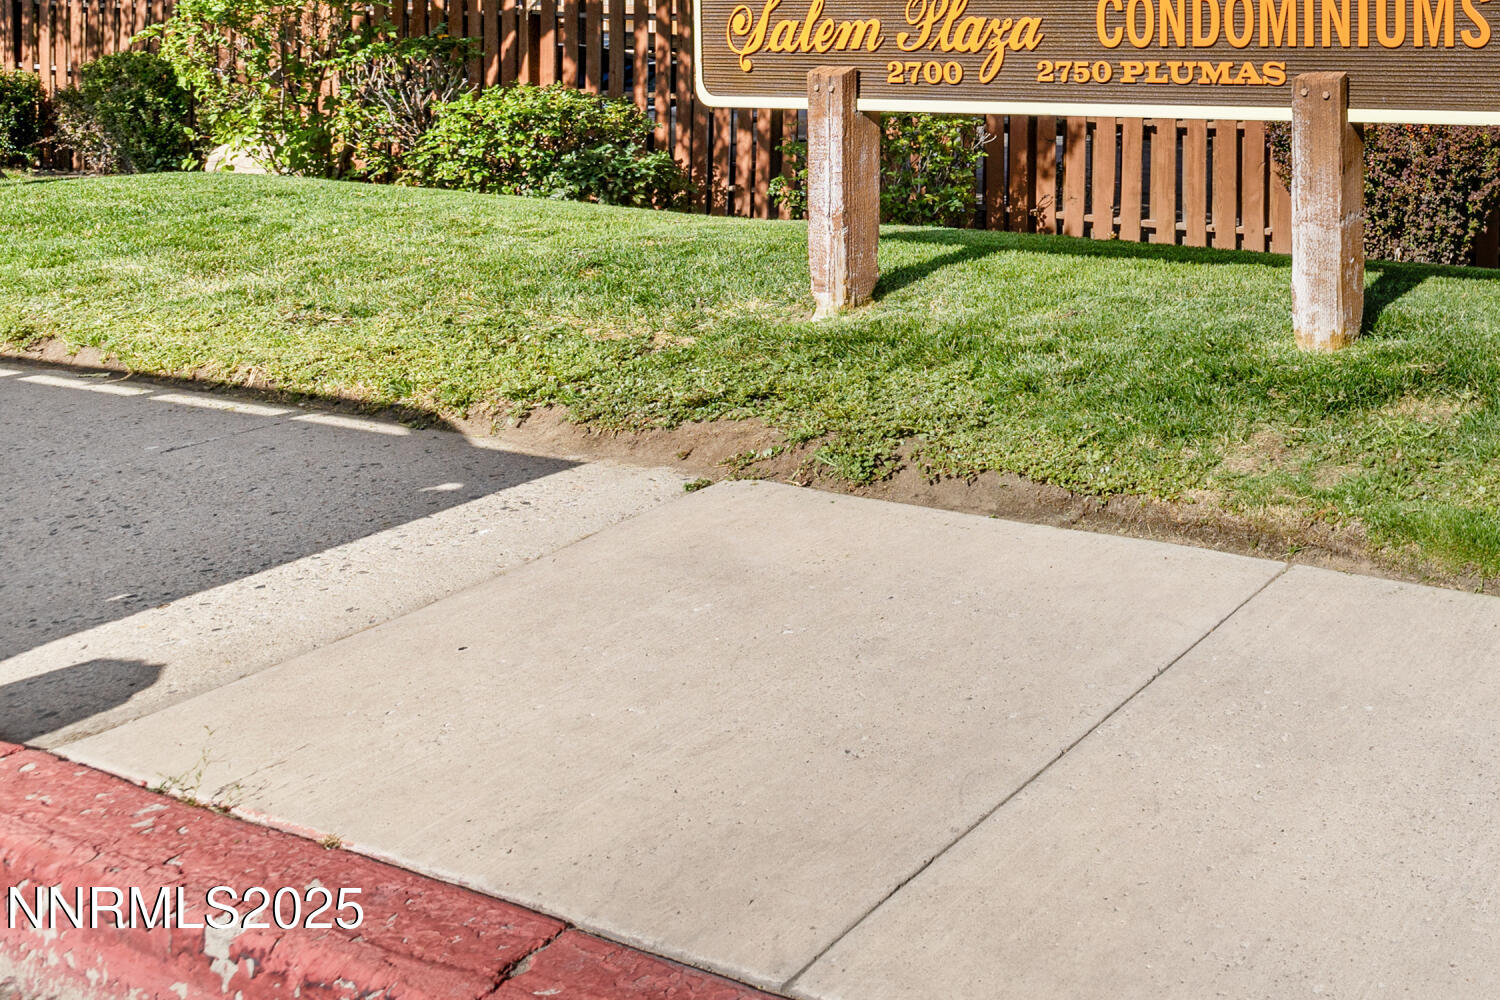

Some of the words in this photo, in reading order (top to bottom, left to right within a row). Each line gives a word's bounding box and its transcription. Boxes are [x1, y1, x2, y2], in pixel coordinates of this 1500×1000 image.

[887, 61, 963, 85] 2700
[1037, 61, 1112, 83] 2750
[1120, 61, 1287, 86] PLUMAS
